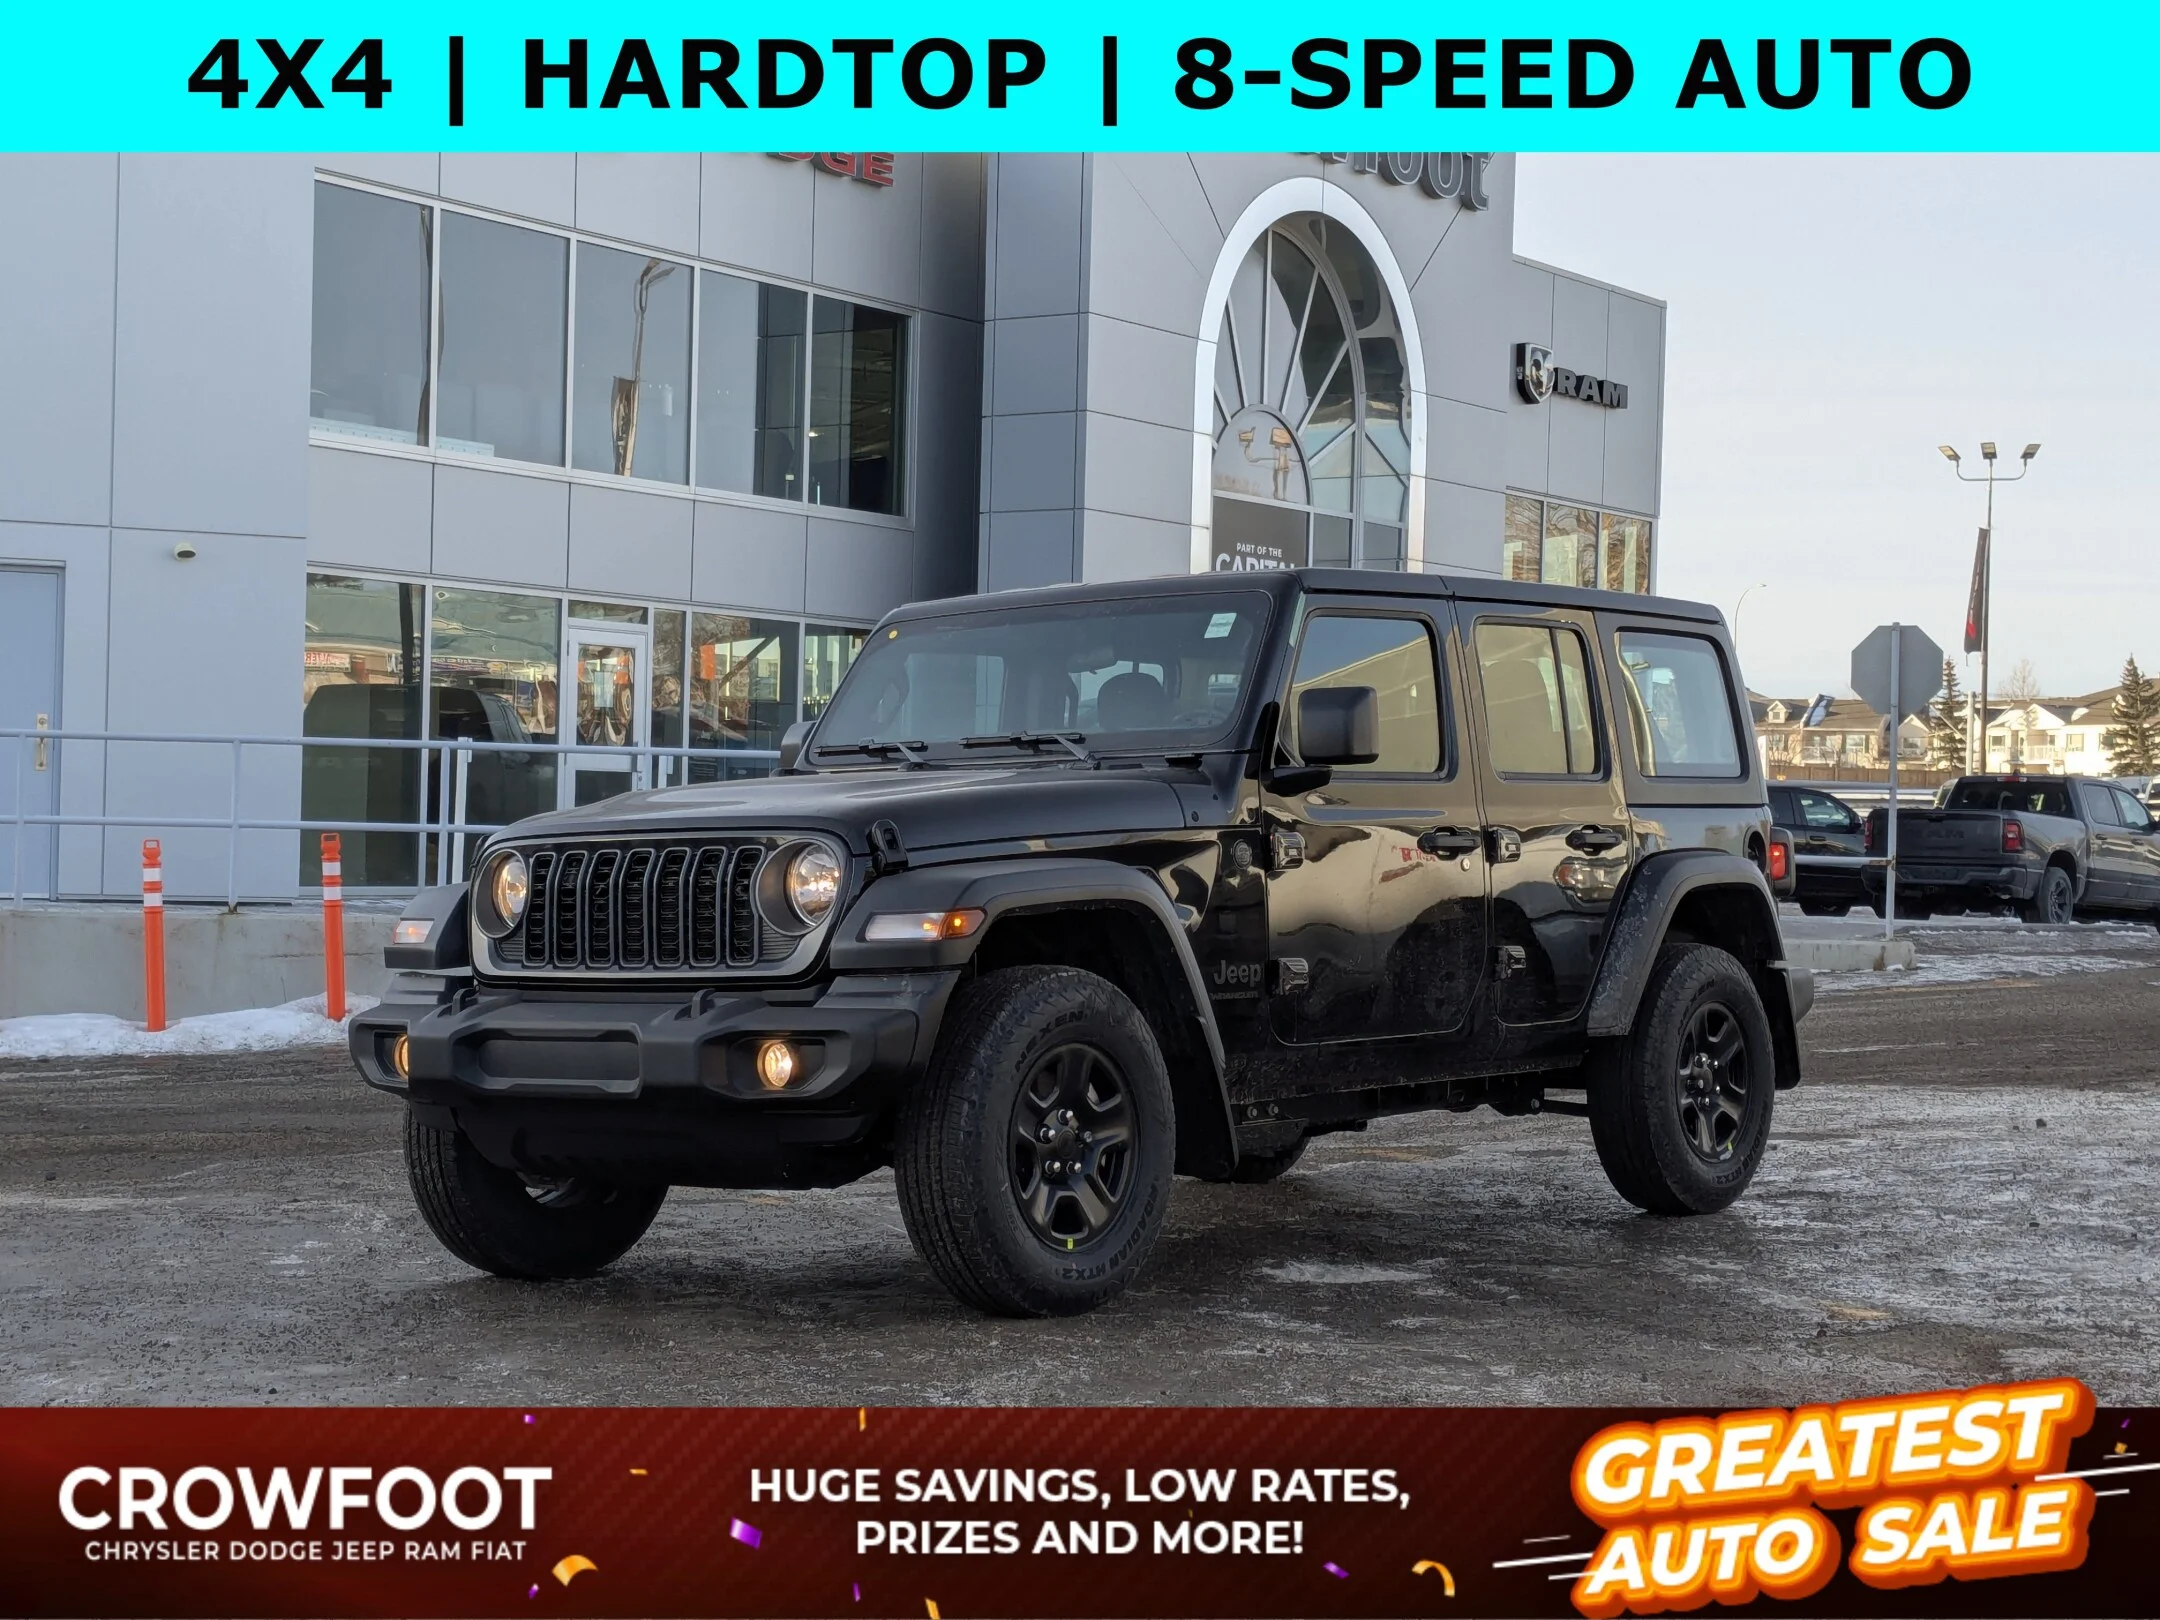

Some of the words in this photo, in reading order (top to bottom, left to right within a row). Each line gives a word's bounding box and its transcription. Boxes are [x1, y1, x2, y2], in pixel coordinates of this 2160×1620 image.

[1555, 366, 1628, 409] RAM
[1236, 542, 1256, 554] PART
[1256, 545, 1267, 556] OF
[1268, 547, 1283, 558] THE
[1213, 959, 1262, 988] Jeep
